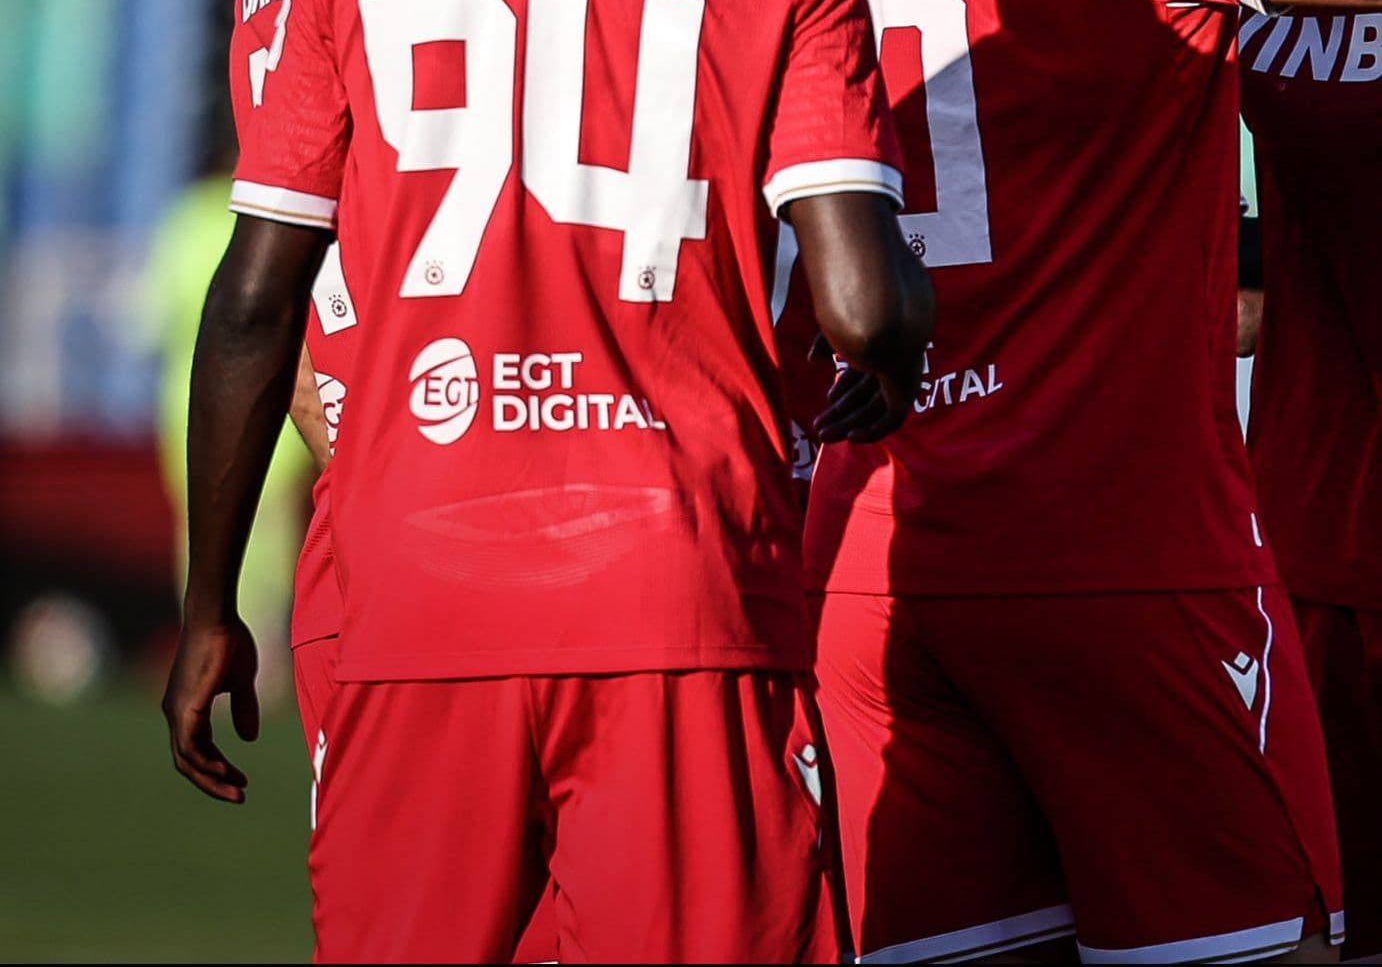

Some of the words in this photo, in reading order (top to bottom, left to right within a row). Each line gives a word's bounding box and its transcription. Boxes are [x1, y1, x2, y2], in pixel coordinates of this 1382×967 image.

[492, 352, 583, 390] EGT
[913, 363, 1004, 413] GITAL
[423, 375, 478, 407] EGT
[492, 394, 666, 431] DIGITAL
